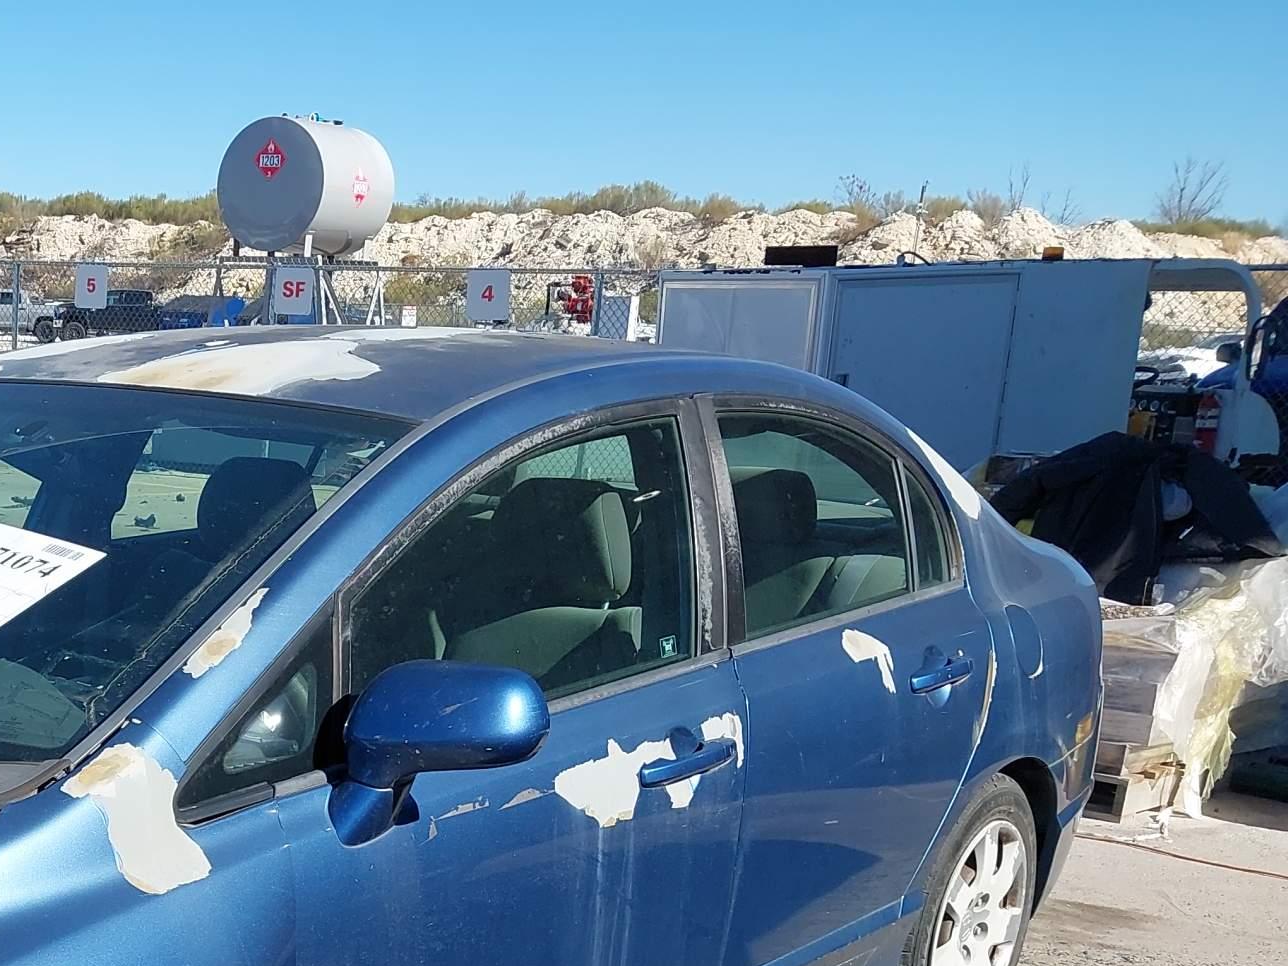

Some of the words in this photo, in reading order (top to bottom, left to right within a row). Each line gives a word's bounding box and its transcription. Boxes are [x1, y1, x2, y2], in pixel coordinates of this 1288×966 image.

[261, 155, 280, 167] 1203
[87, 278, 96, 293] 5
[282, 281, 306, 298] SF
[481, 286, 494, 301] 4
